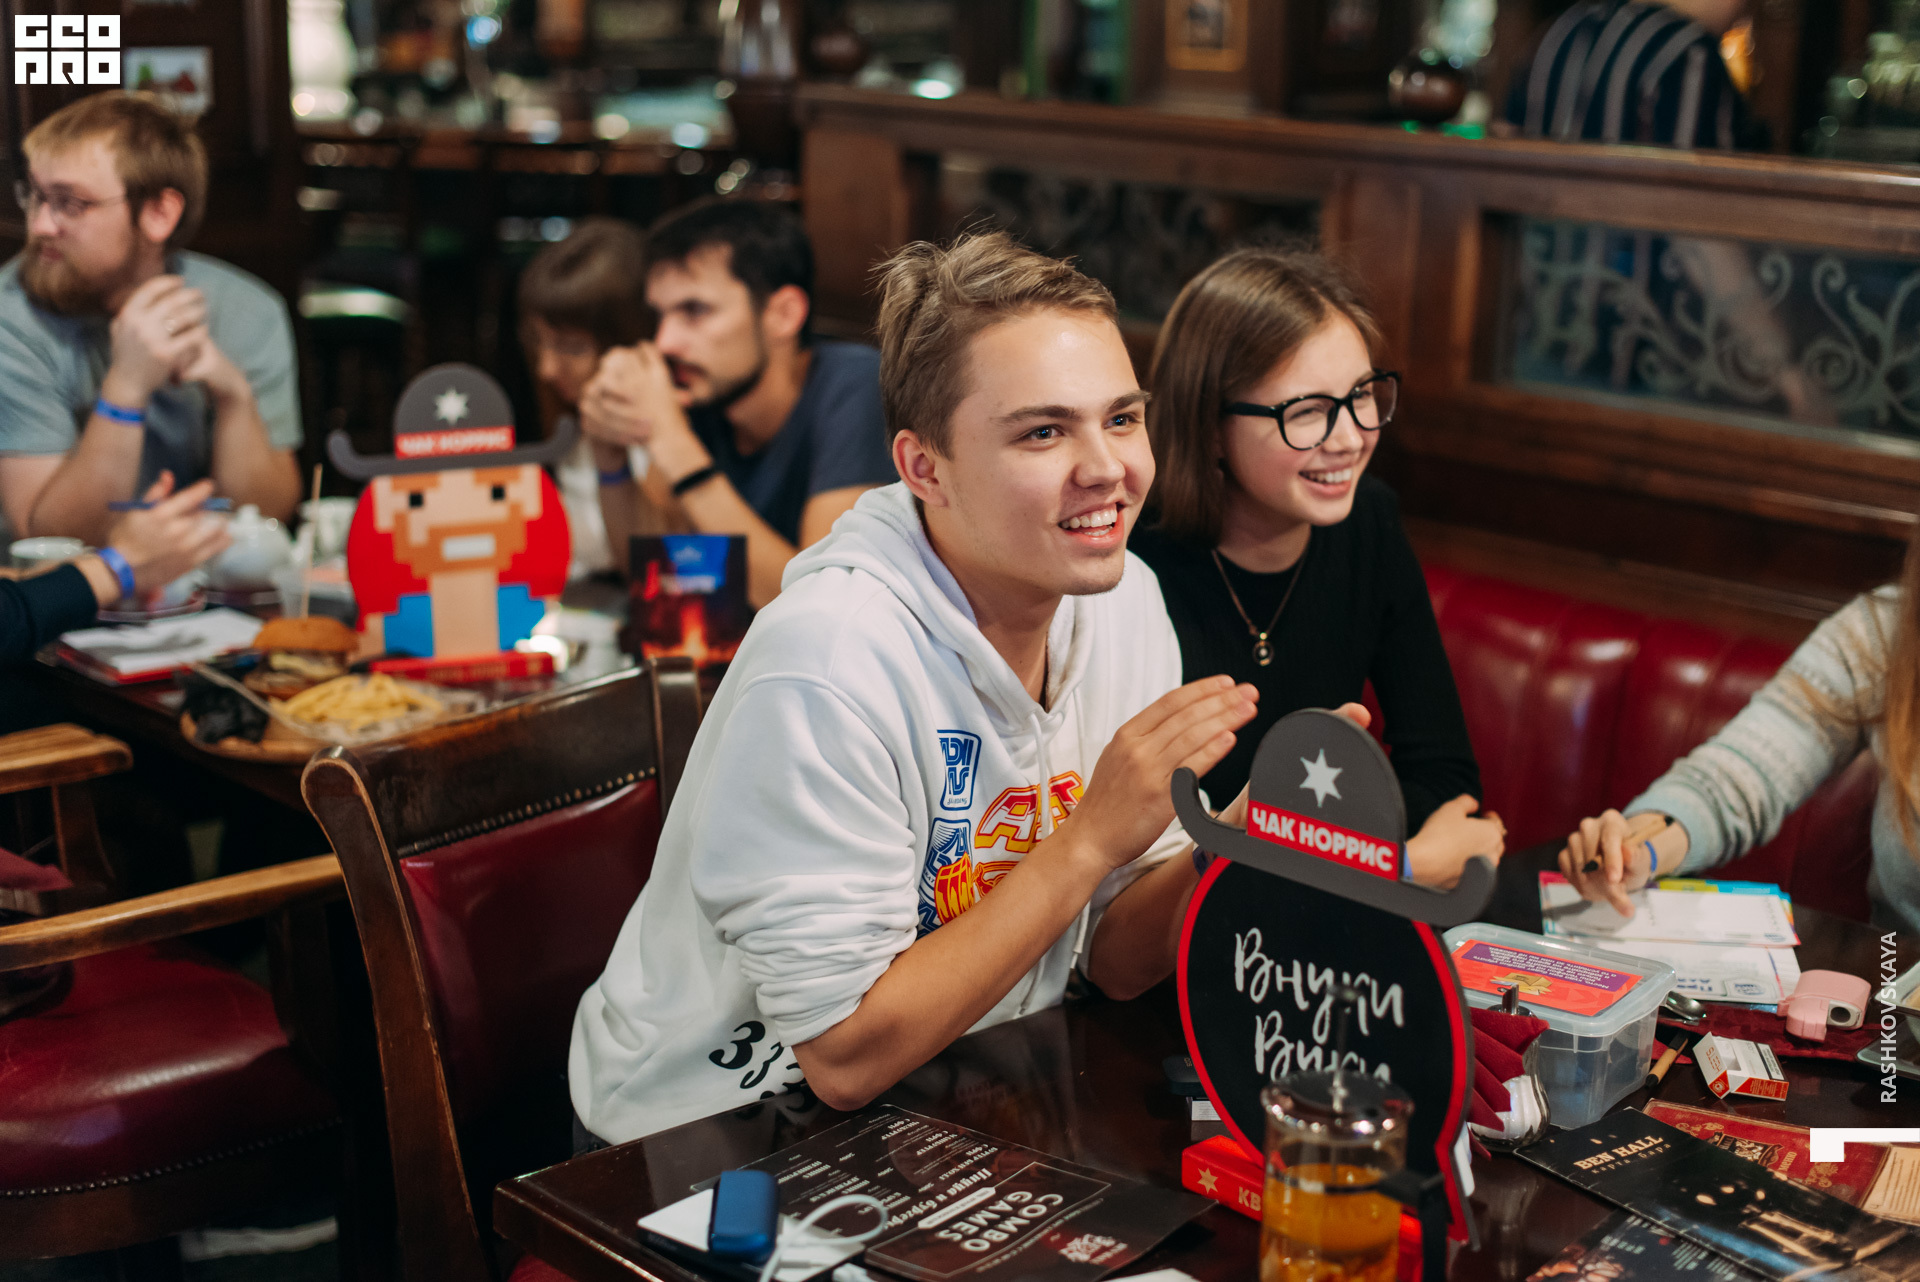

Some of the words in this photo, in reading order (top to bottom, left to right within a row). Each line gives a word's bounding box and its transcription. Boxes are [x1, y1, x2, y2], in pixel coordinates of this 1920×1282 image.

[1252, 808, 1296, 842] ЧАК
[1298, 822, 1395, 873] НОРРИС
[708, 1021, 765, 1070] 3
[1573, 1147, 1613, 1171] BEN
[1612, 1134, 1664, 1161] HALL
[1591, 1158, 1631, 1175] карта
[947, 1168, 992, 1196] Пицца
[1238, 1186, 1262, 1213] КВ
[936, 1191, 1032, 1241] GAMES
[963, 1194, 1063, 1251] COMBO
